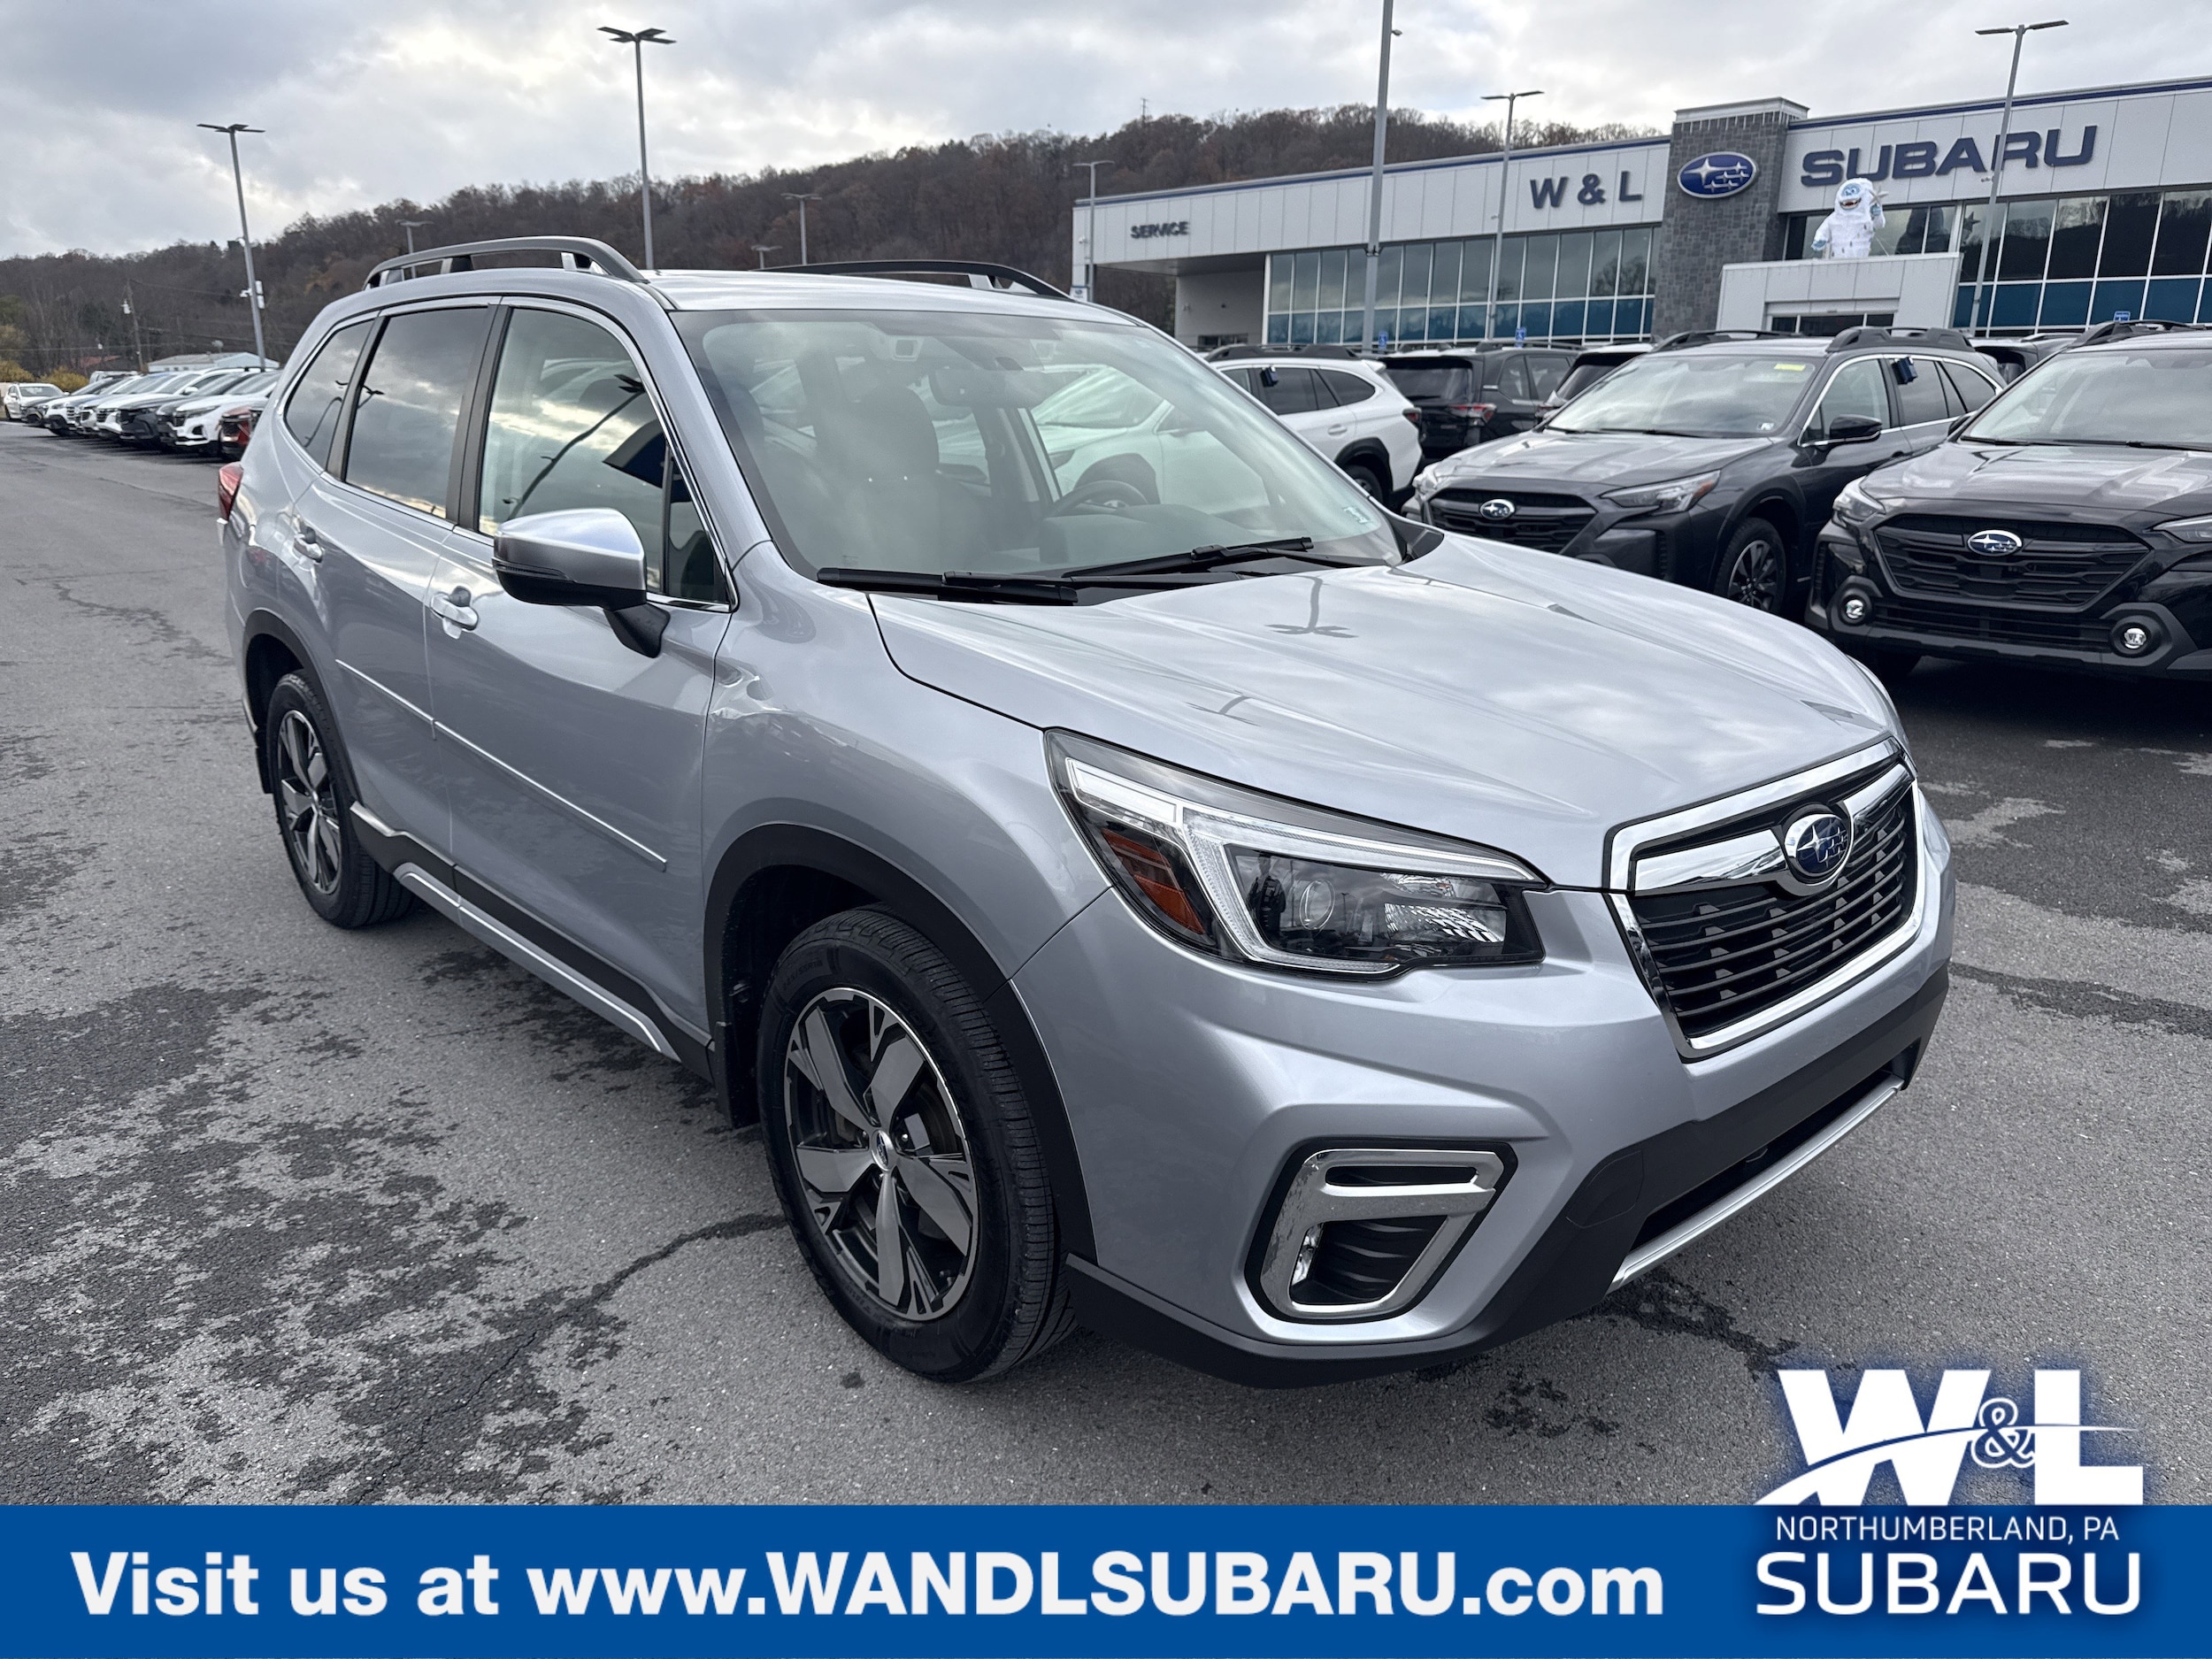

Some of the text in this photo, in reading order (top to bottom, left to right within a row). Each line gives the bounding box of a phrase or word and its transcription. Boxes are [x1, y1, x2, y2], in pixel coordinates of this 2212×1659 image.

[1801, 126, 2098, 187] SUBARU
[1530, 171, 1642, 209] W & L
[1131, 221, 1188, 239] SERVICE
